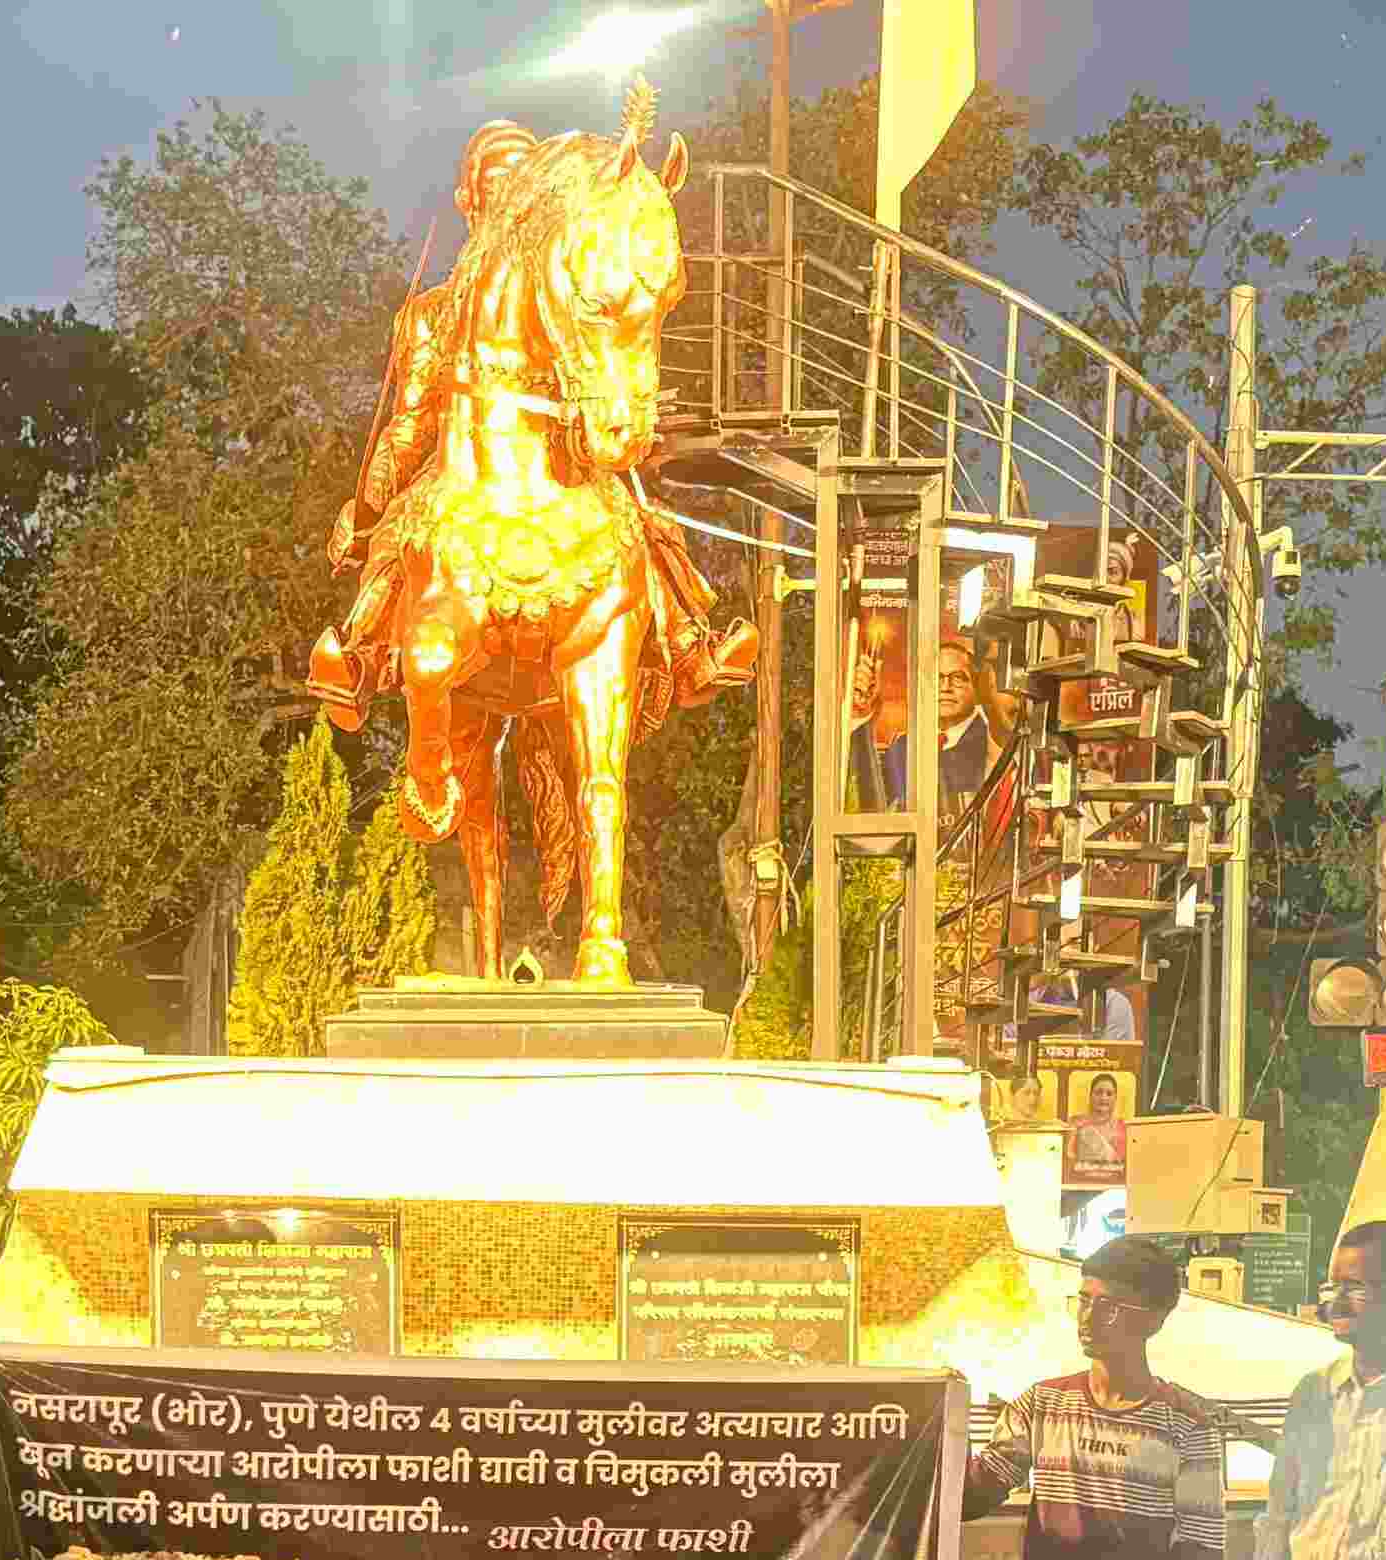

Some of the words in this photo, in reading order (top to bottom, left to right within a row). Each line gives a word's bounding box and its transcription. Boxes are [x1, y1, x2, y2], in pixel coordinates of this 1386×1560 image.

[9, 1390, 144, 1435] नसरापूर
[152, 1390, 253, 1434] (भोर),
[260, 1393, 319, 1439] पुणे
[323, 1393, 424, 1433] येथील
[429, 1407, 453, 1433] 4
[576, 1400, 690, 1447] मुलीवर
[695, 1410, 825, 1439] अत्याचार
[830, 1402, 909, 1440] आणि
[15, 1436, 75, 1481] खून
[230, 1442, 381, 1481] आरोपीला
[386, 1446, 474, 1484] फाशी
[478, 1448, 550, 1485] द्यावी
[553, 1458, 580, 1485] व
[584, 1449, 725, 1497] चिमुकली
[728, 1451, 842, 1499] मुलीला
[18, 1487, 160, 1527] श्रद्धांजली
[167, 1492, 253, 1531] अर्पण
[487, 1516, 649, 1551] आरोपीला
[656, 1519, 755, 1553] फाशी
